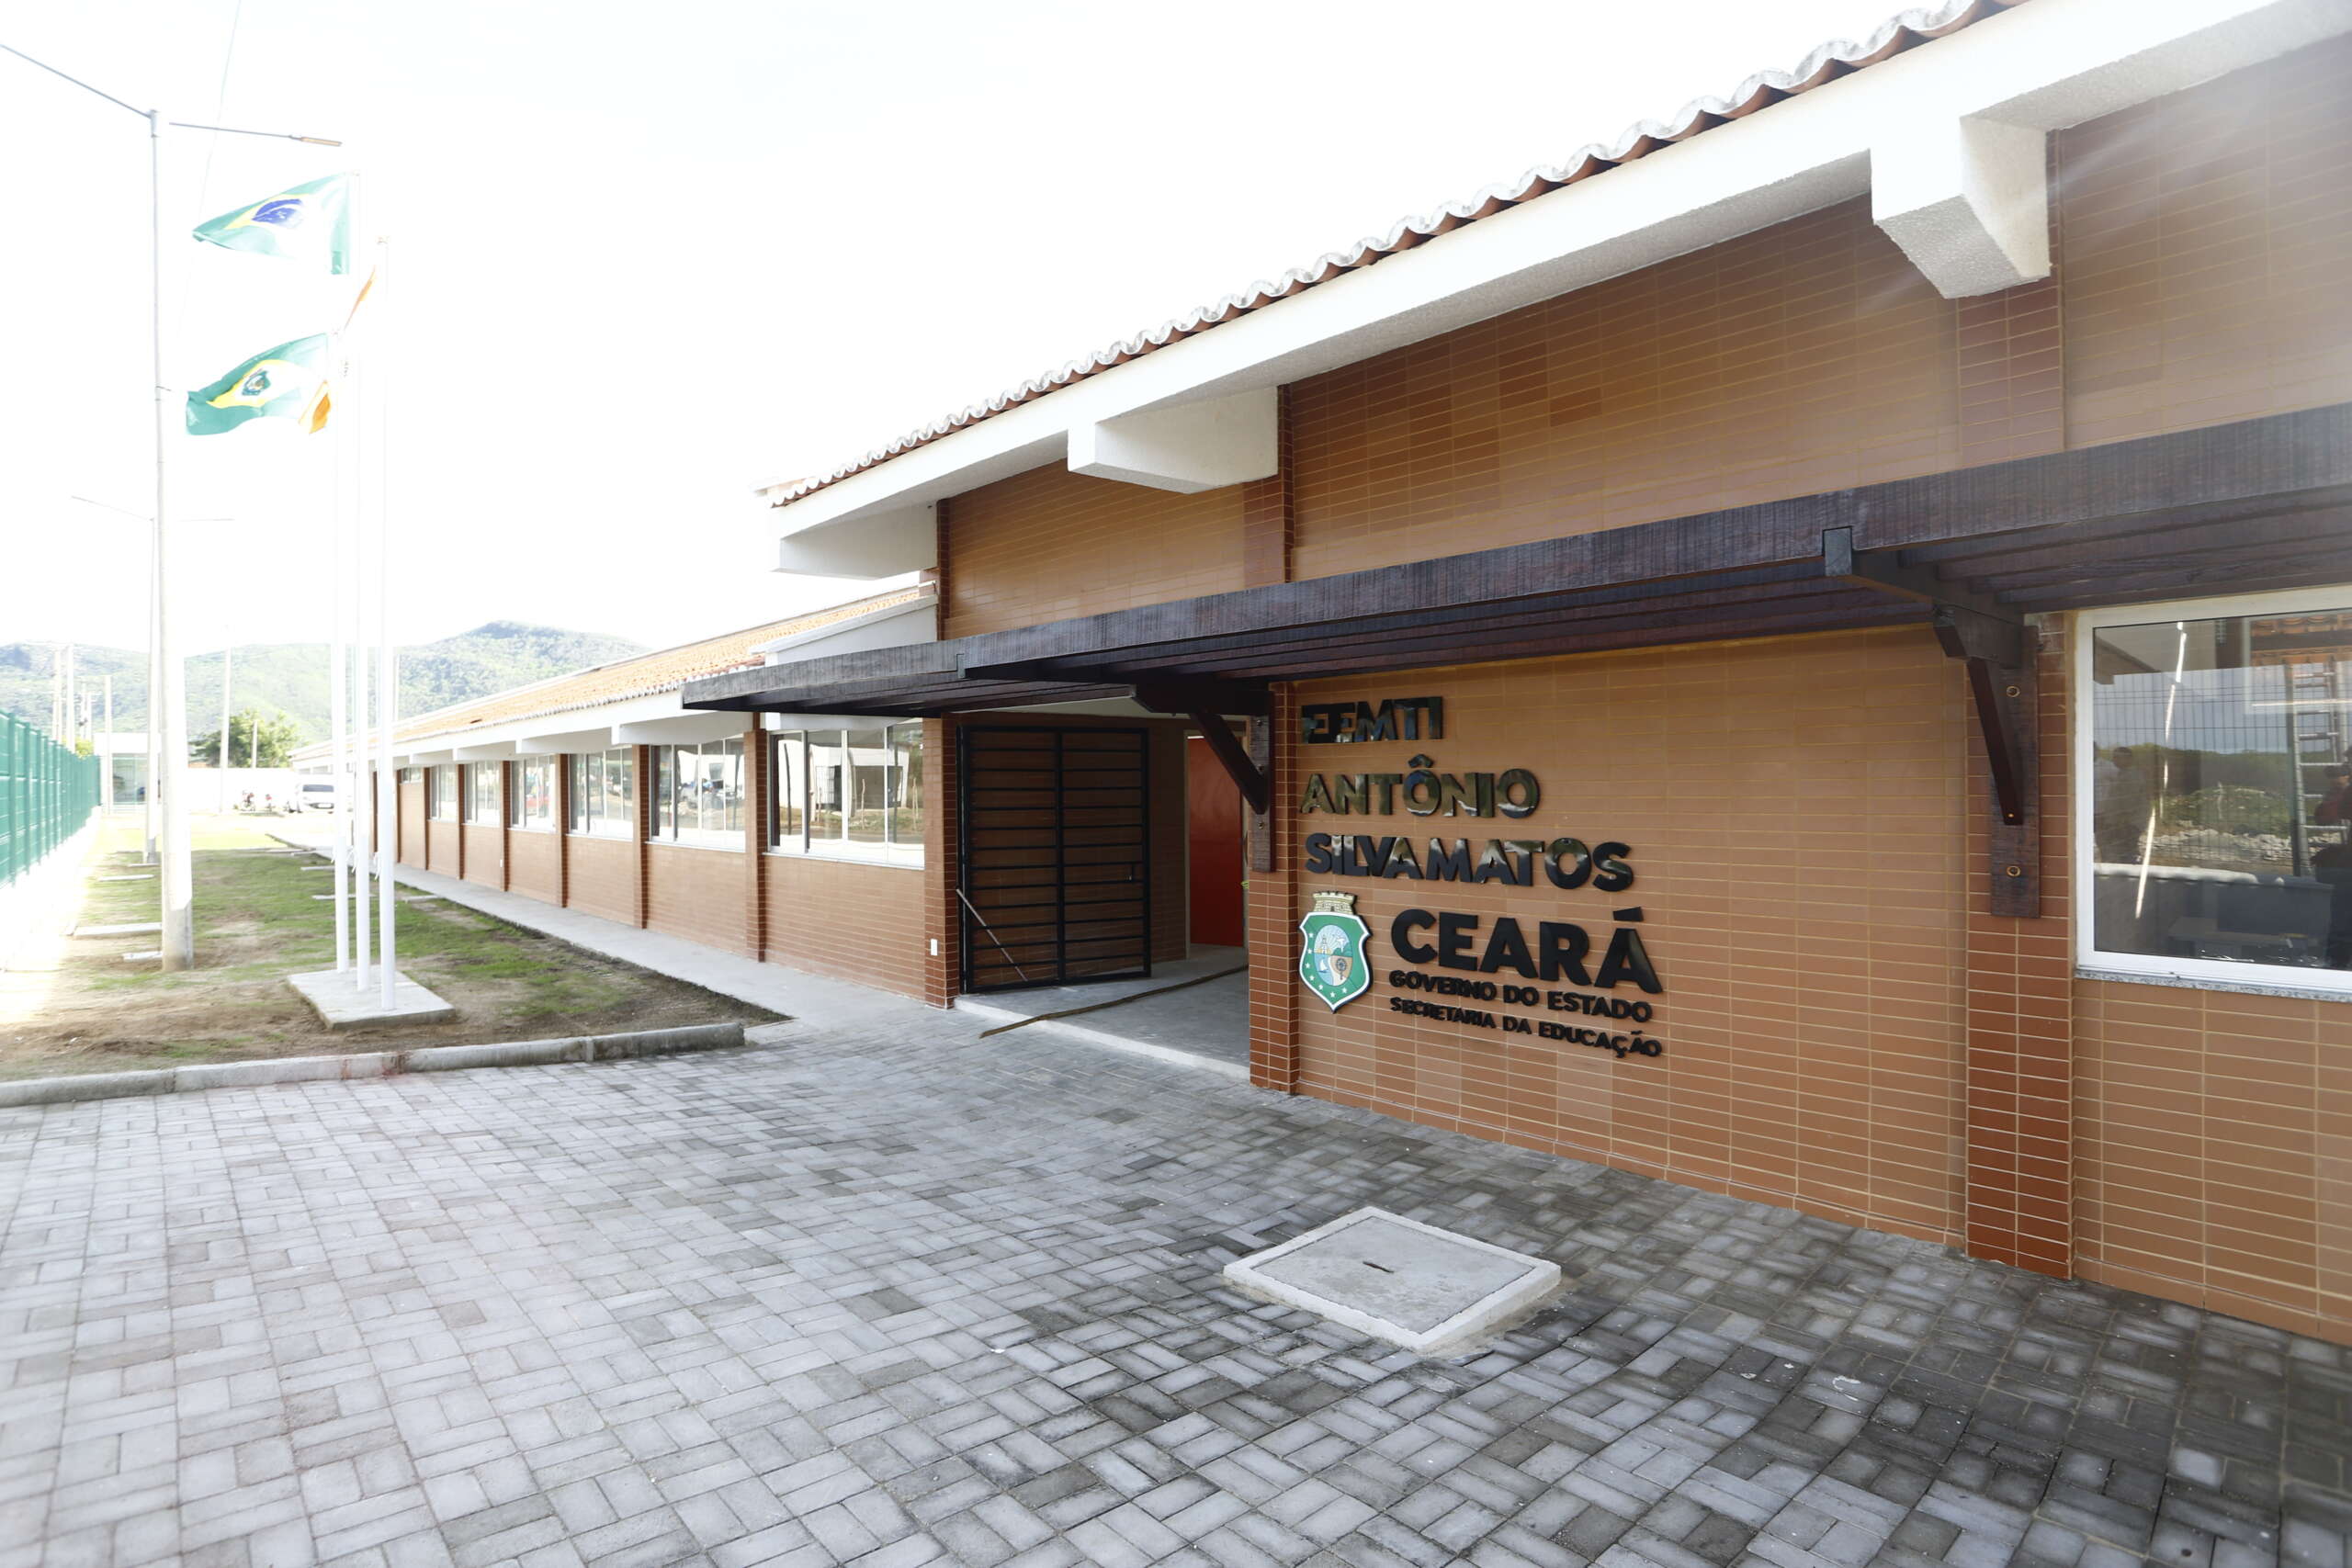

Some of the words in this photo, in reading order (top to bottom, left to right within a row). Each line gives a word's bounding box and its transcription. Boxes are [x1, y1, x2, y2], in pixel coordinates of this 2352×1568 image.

[1301, 696, 1443, 743] EEMTI
[1300, 754, 1540, 818] ANTÔNIO
[1306, 833, 1634, 892] SILVAMATOS
[1391, 907, 1663, 994] CEARÁ
[1389, 970, 1498, 1001] GOVERNO
[1503, 986, 1540, 1006] DO
[1547, 991, 1653, 1023] ESTADO
[1390, 997, 1497, 1028] SECRETARIA
[1503, 1015, 1532, 1034] DA
[1539, 1021, 1663, 1058] EDUCAÇÃO
